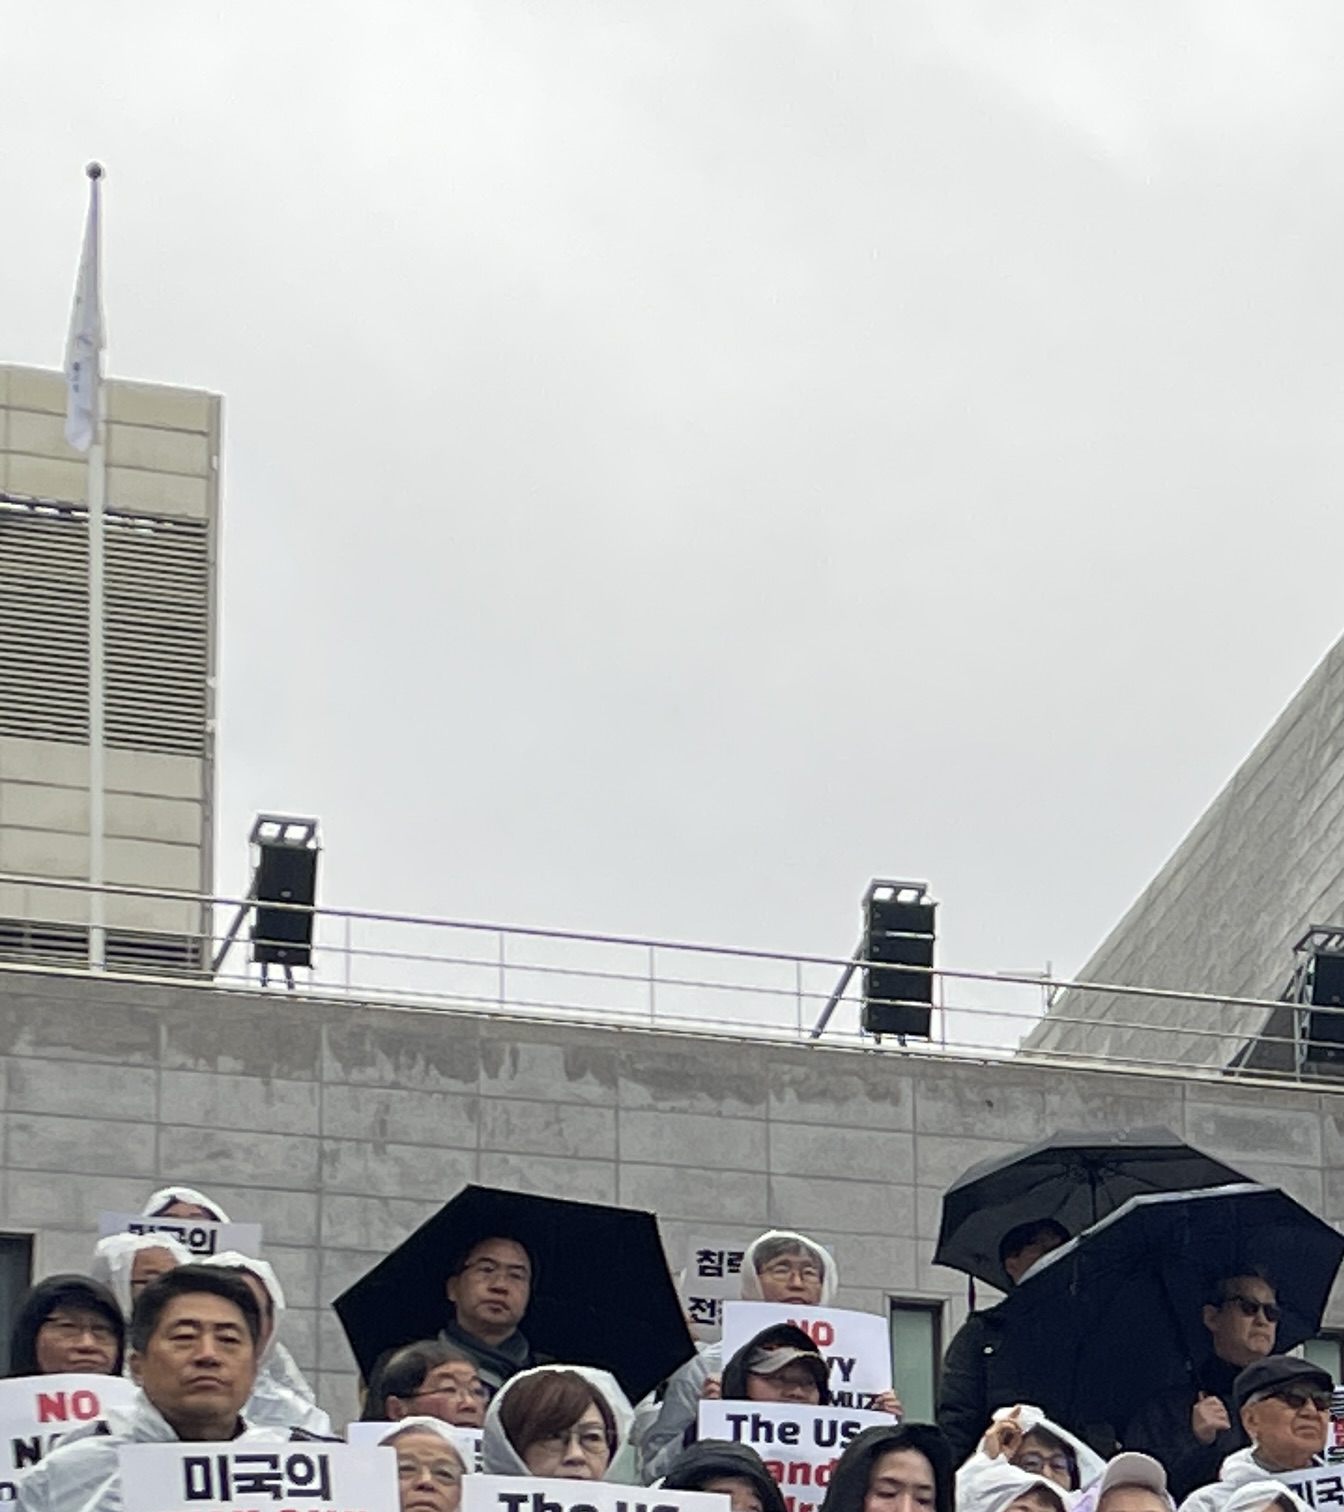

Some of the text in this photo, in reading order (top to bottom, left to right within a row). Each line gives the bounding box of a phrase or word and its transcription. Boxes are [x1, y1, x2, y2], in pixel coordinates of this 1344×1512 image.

[37, 1390, 100, 1423] NO
[726, 1413, 800, 1445] The
[183, 1453, 332, 1501] 미국의
